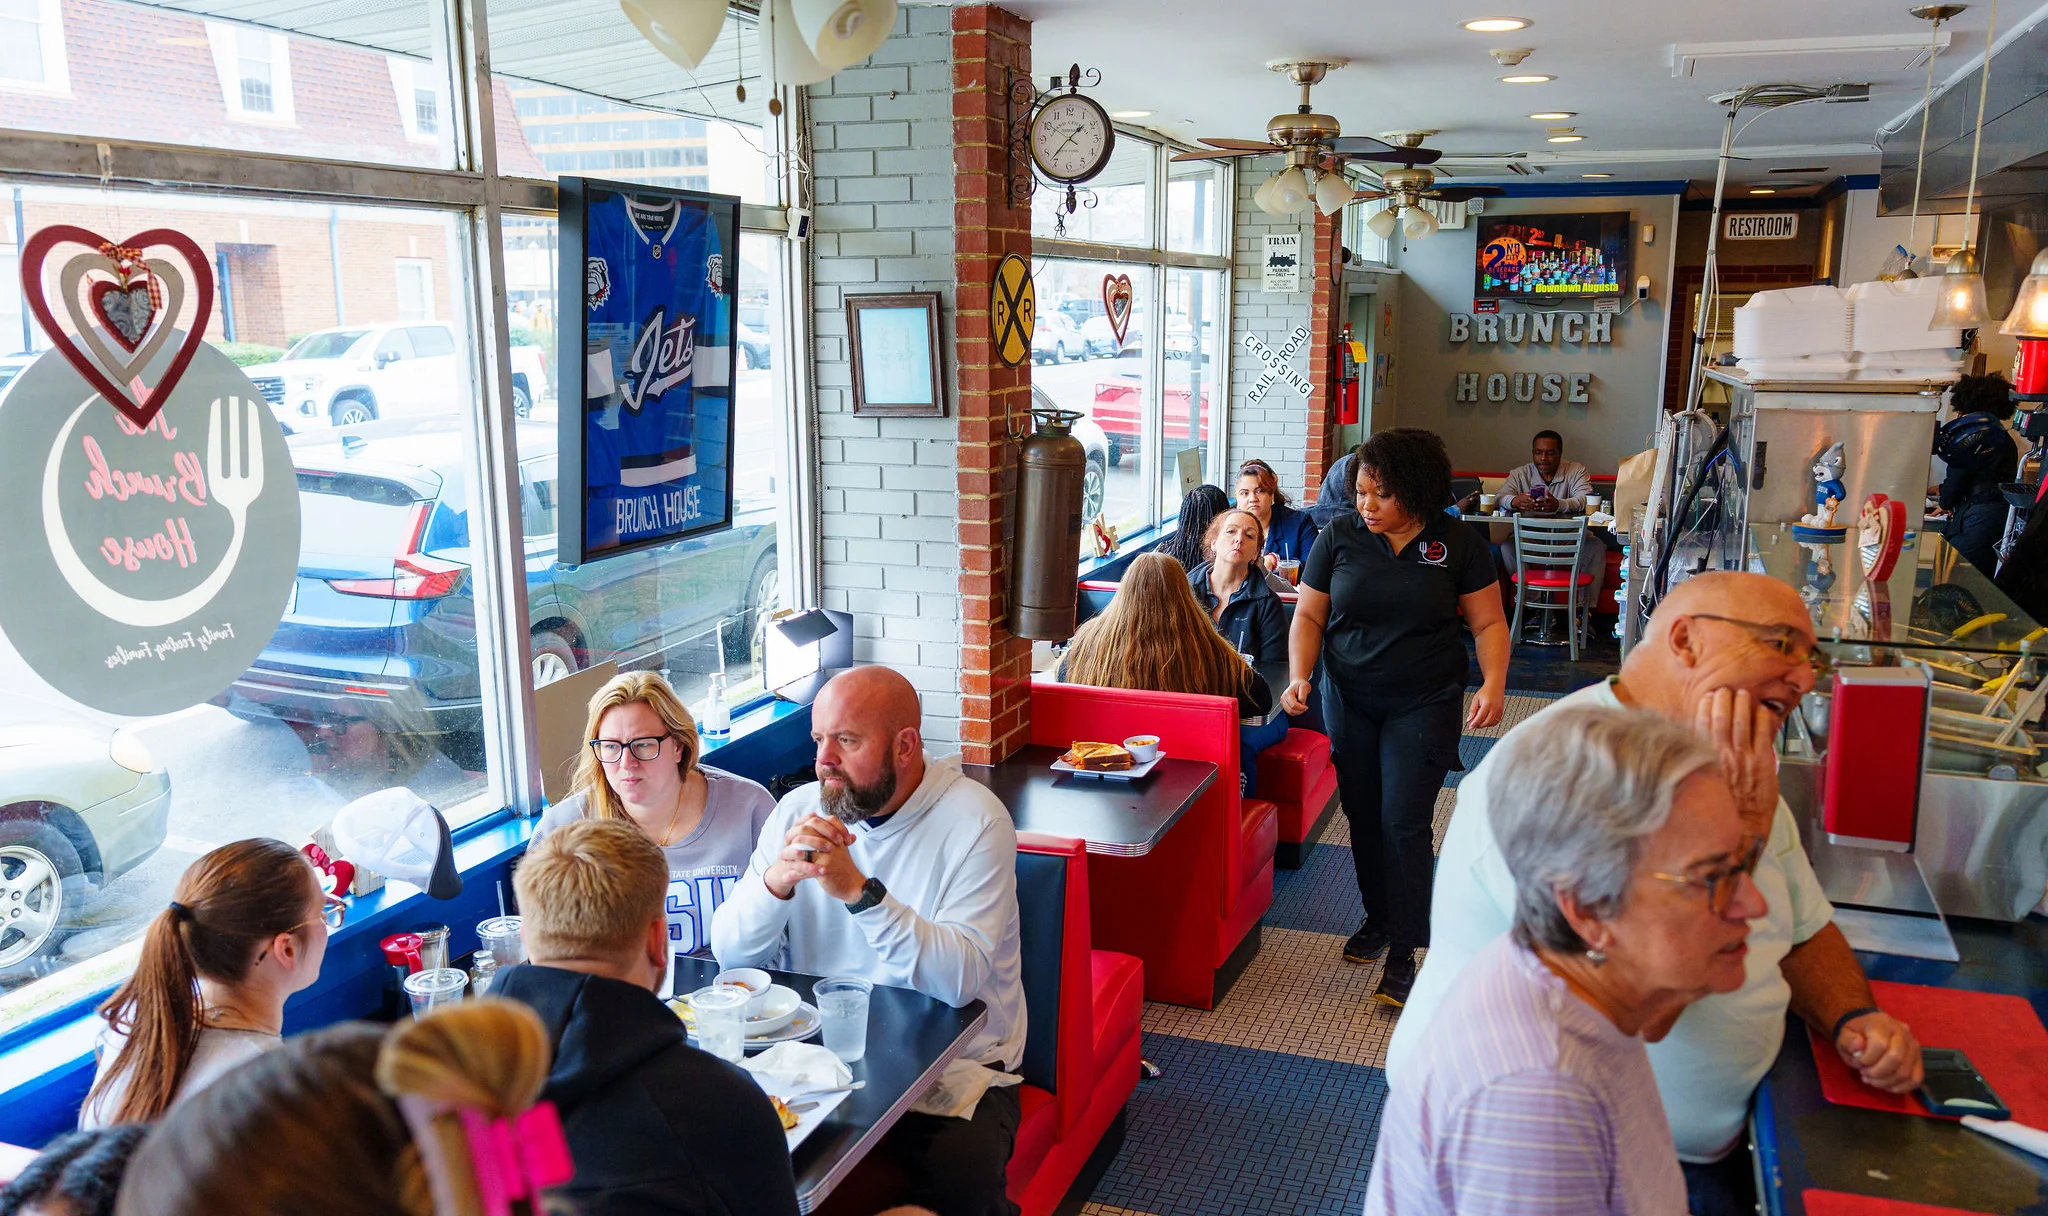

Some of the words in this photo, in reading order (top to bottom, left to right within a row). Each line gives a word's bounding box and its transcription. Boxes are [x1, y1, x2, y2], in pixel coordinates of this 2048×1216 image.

[1066, 107, 1074, 116] 12
[1729, 217, 1793, 236] RESTROOM
[1267, 237, 1297, 245] TRAIN
[1535, 283, 1581, 293] Downtown
[1582, 283, 1619, 293] Augusta
[1023, 298, 1032, 322] R
[1449, 312, 1613, 343] BRUNCH
[619, 310, 696, 411] Jets
[1245, 336, 1310, 394] CROSSING
[1456, 372, 1591, 403] HOUSE
[616, 494, 662, 535] BRUNCH
[663, 485, 702, 527] HOUSE
[669, 870, 691, 878] TATE
[692, 865, 738, 877] UNIVERSITY
